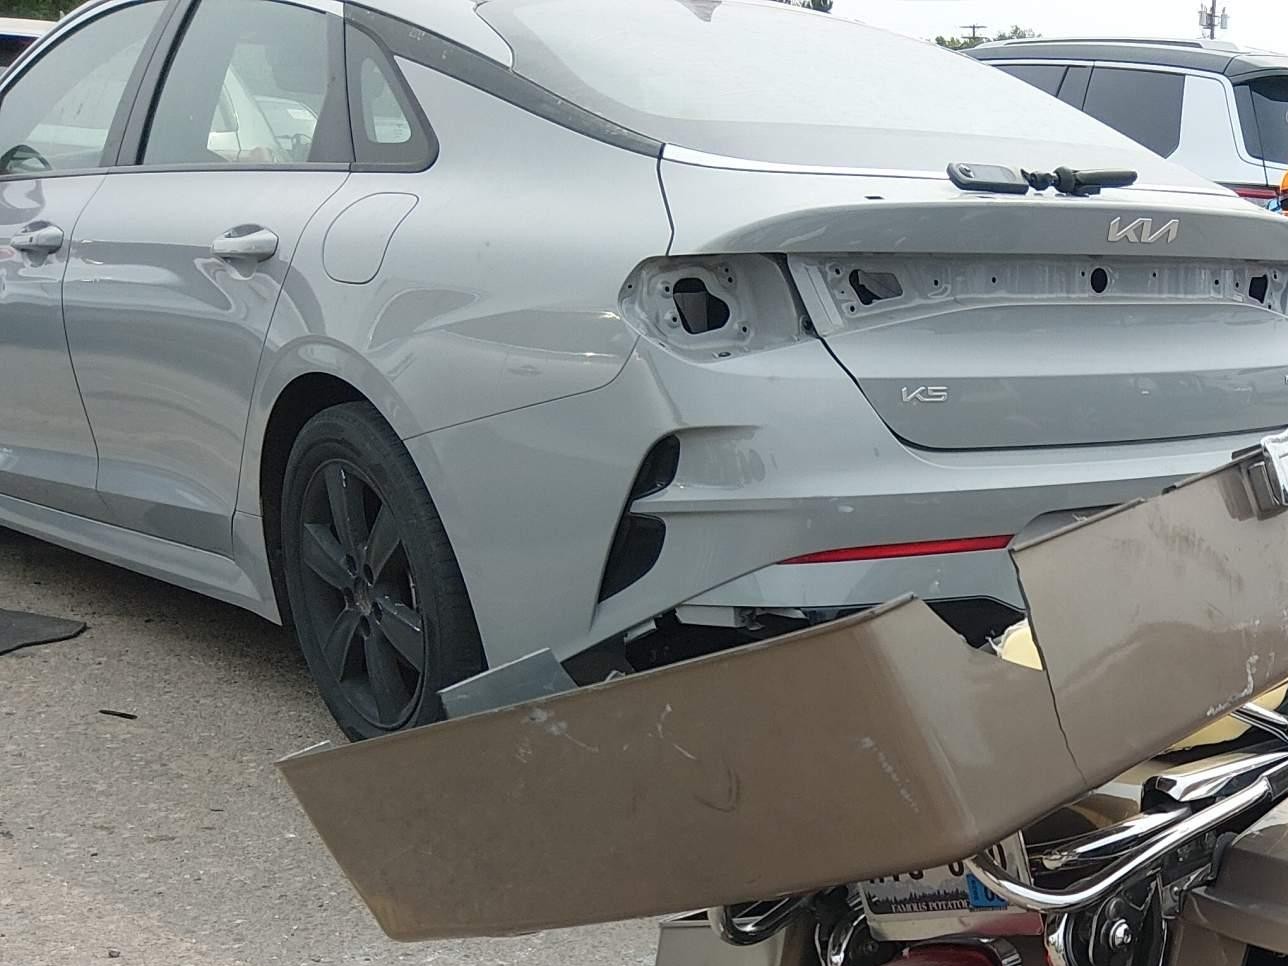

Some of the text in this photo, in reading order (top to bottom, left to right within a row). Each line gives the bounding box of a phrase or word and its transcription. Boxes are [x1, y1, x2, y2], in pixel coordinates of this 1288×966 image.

[1107, 216, 1179, 243] KIA
[901, 386, 948, 402] K5
[891, 899, 968, 913] FAMOUS POTATO
